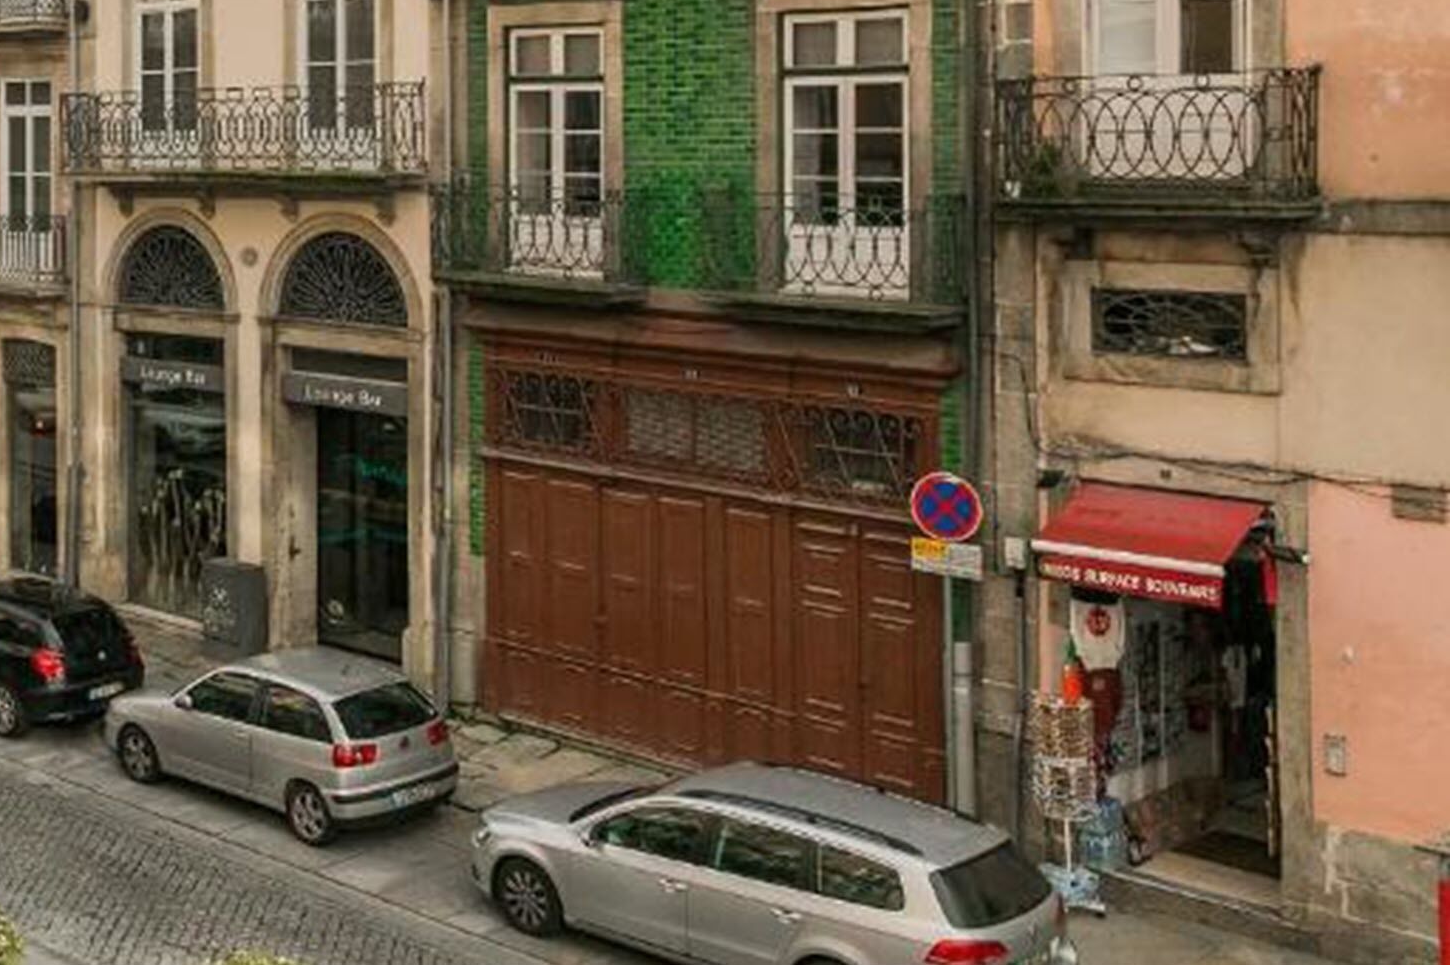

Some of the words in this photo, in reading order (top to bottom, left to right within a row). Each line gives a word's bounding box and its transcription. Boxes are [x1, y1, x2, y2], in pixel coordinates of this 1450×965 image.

[140, 365, 182, 386] Lounge
[185, 369, 206, 385] Bar
[304, 384, 355, 405] Lounge
[358, 389, 383, 406] Bar
